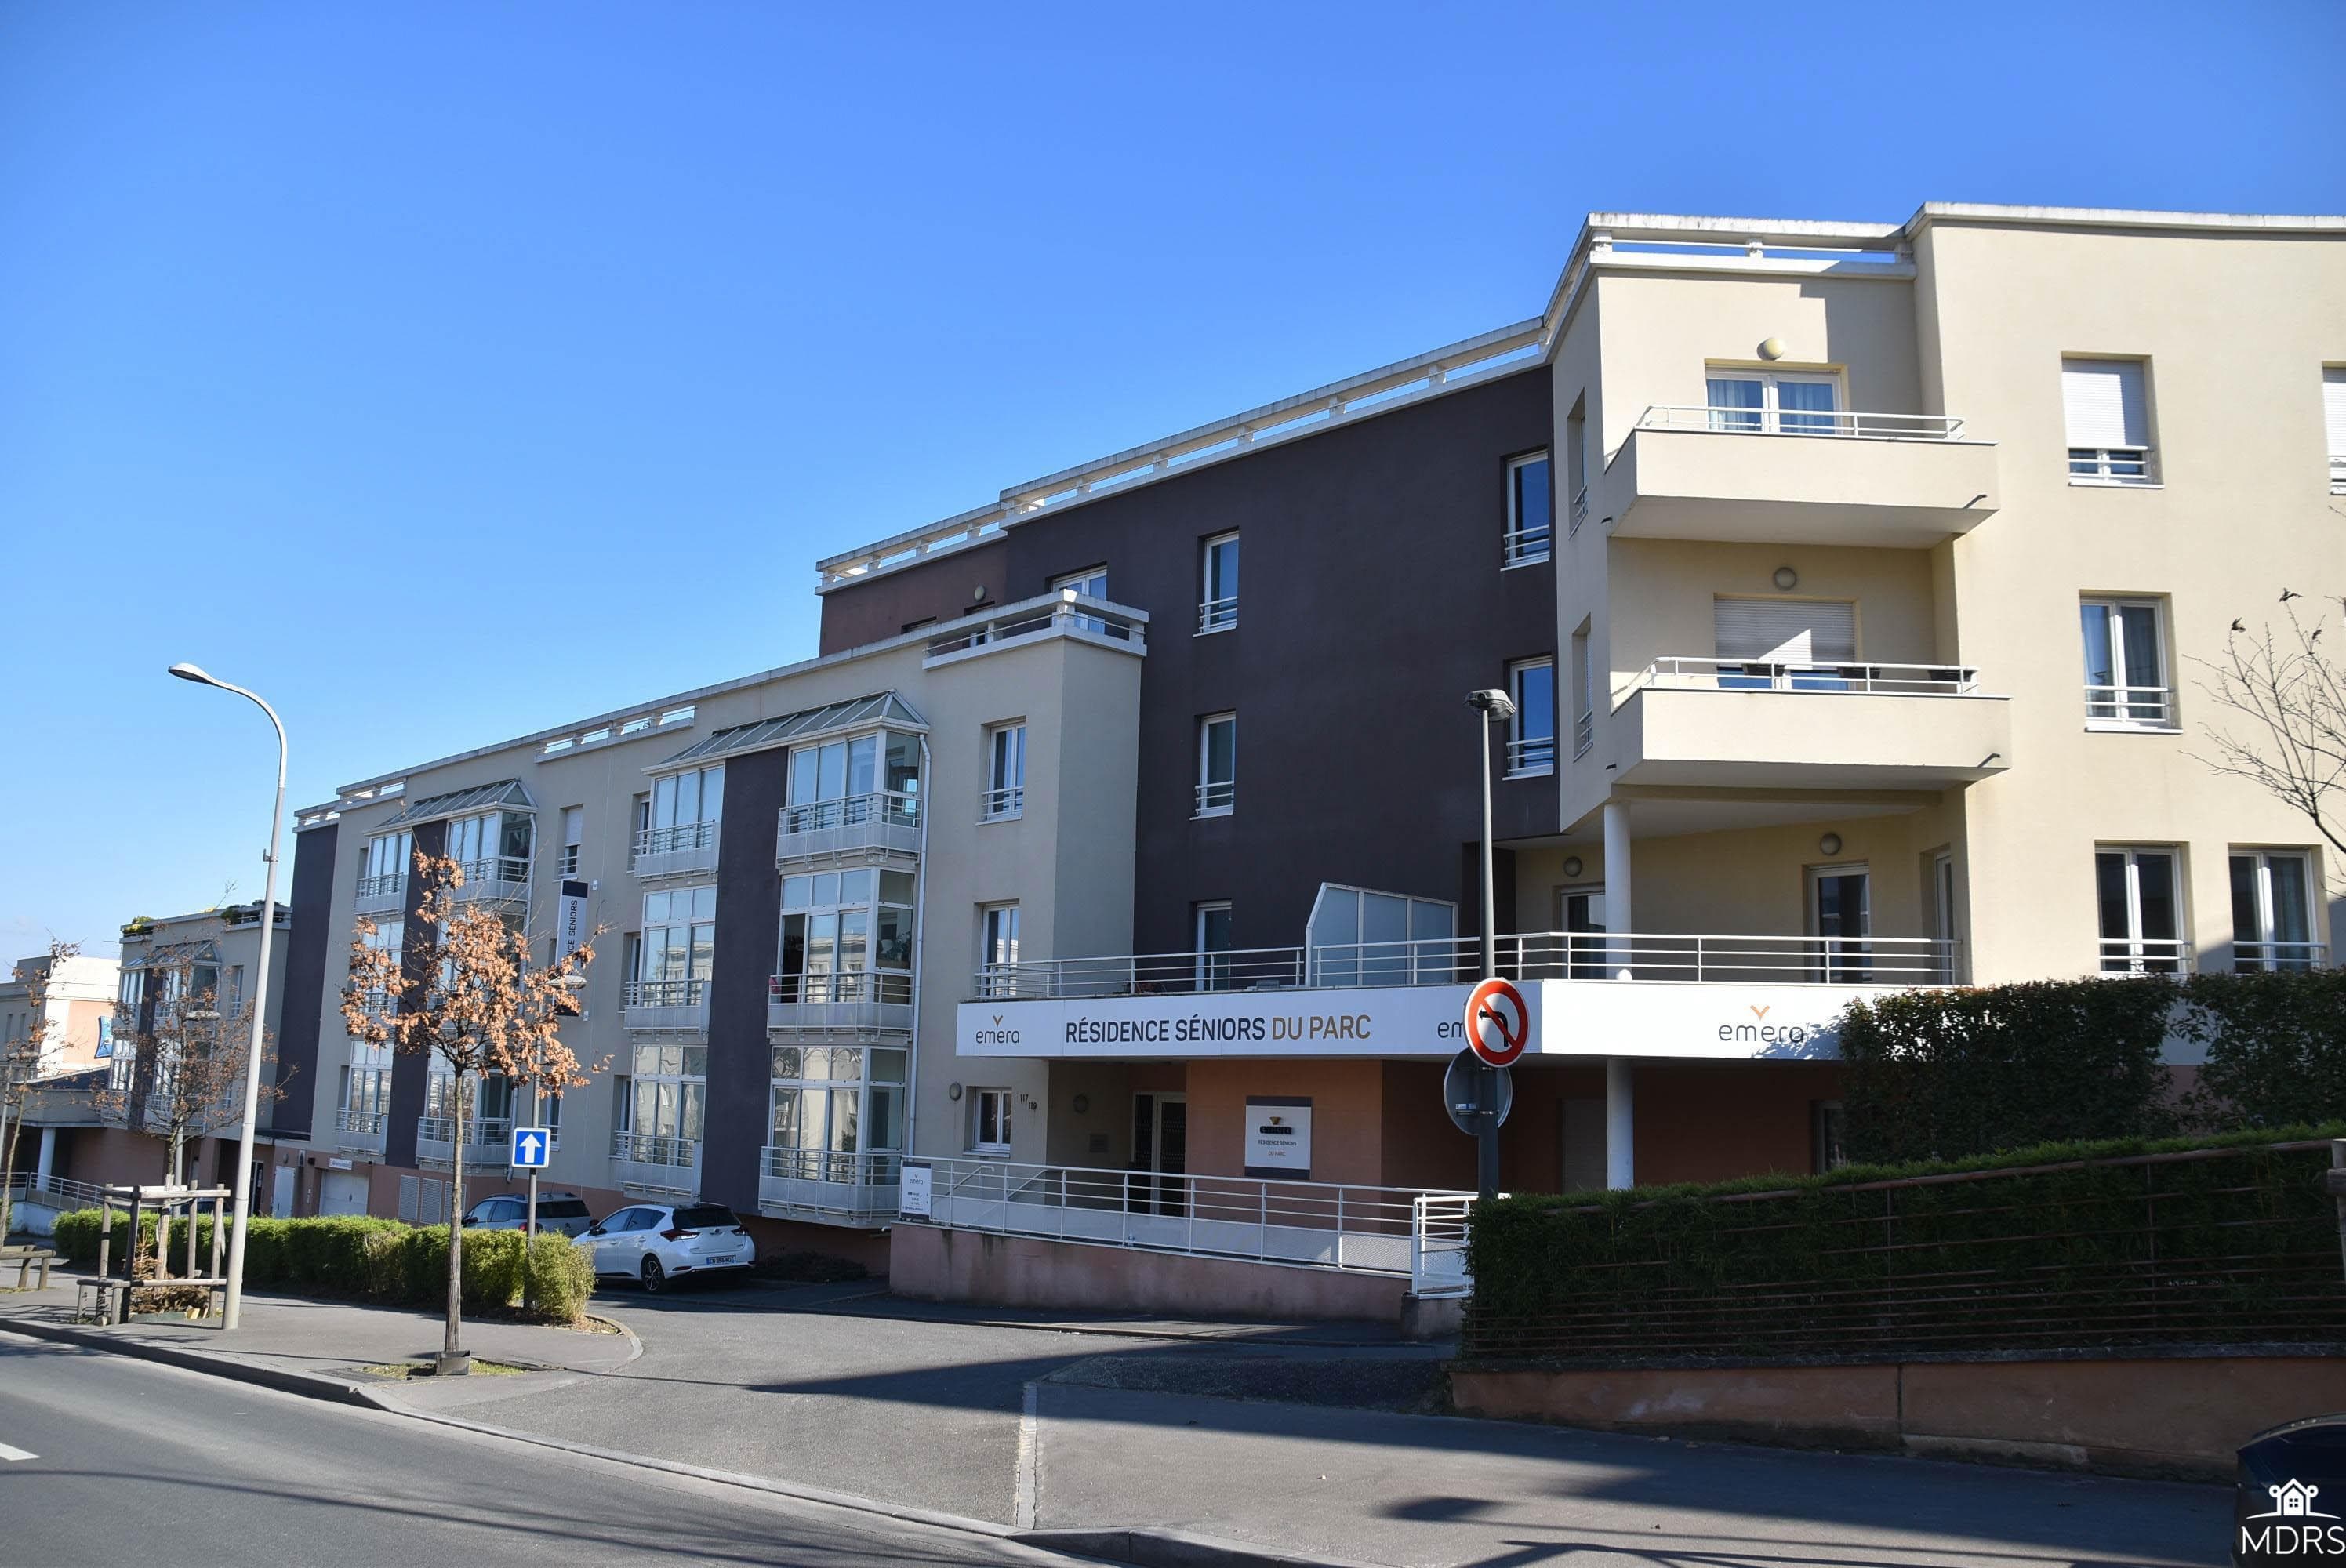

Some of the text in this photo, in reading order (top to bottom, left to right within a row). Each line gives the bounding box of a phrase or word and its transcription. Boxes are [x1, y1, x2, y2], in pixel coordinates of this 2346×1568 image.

[567, 899, 578, 936] SÉNIORS
[975, 1030, 1020, 1044] emera
[1066, 1014, 1371, 1044] RÉSIDENCE SÉNIORS DU PARC
[1718, 1024, 1804, 1043] emera
[1020, 1094, 1029, 1104] 117
[1028, 1101, 1037, 1112] 119
